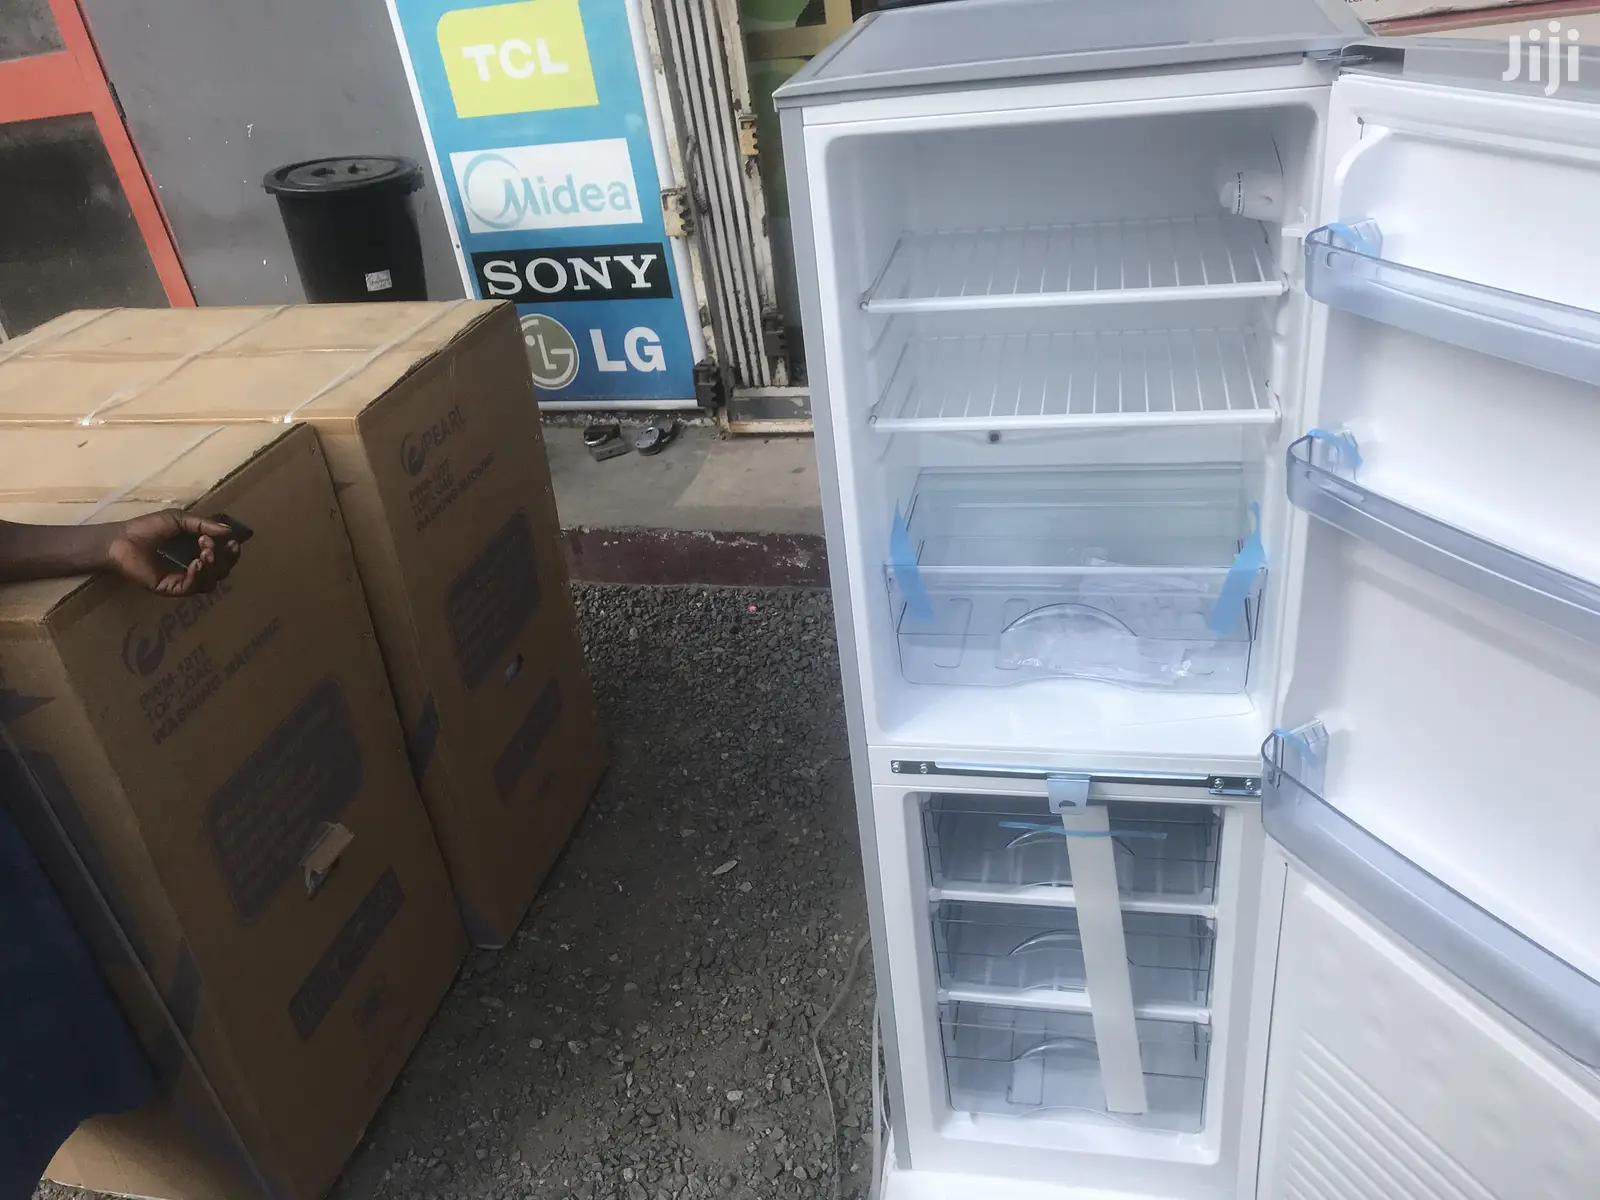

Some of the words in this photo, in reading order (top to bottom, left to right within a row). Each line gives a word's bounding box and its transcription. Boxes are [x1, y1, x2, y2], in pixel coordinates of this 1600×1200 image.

[461, 38, 569, 82] TCL
[483, 253, 657, 296] SONY
[589, 326, 667, 373] LG
[421, 405, 467, 450] PEARL
[152, 673, 223, 745] WASHING
